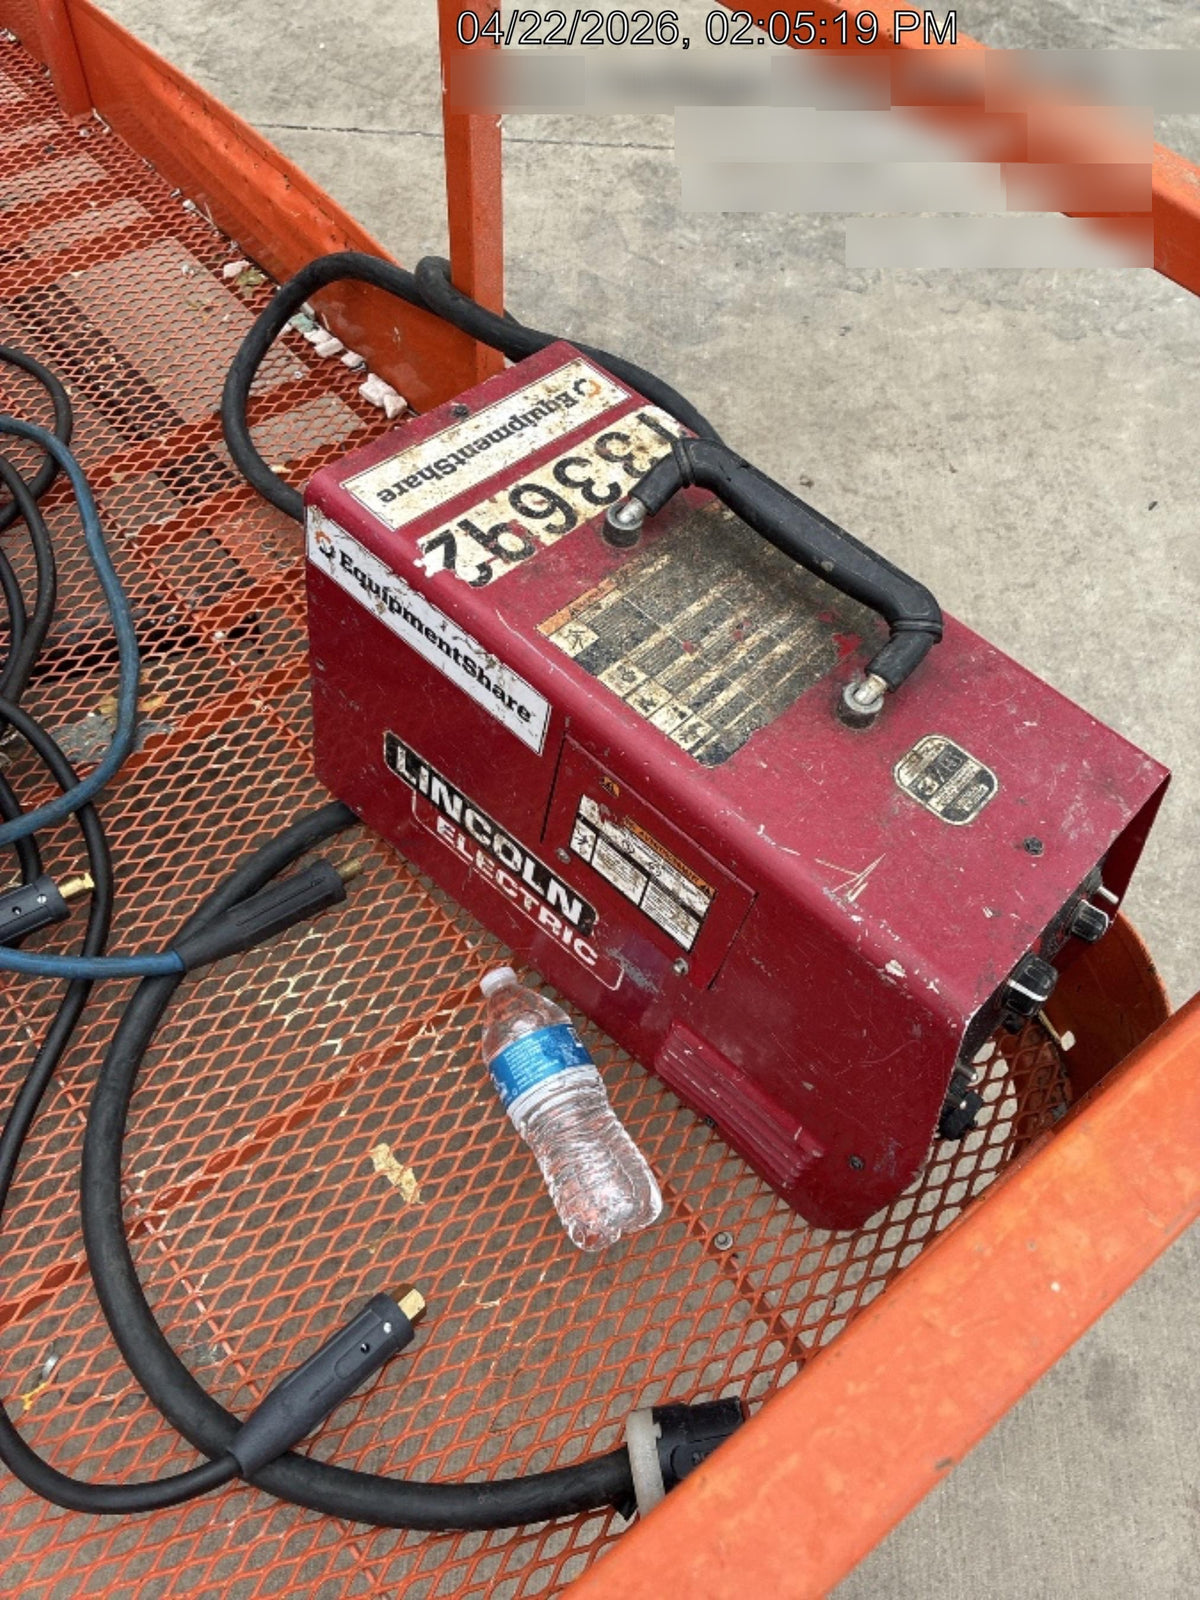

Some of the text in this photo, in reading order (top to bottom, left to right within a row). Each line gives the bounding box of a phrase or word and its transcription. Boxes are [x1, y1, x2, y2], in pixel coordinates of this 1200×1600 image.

[379, 392, 579, 504] EquipmentShare
[339, 549, 533, 723] EquipmentShare
[395, 745, 584, 926] LINCOLN
[436, 815, 599, 967] ELECTRIC
